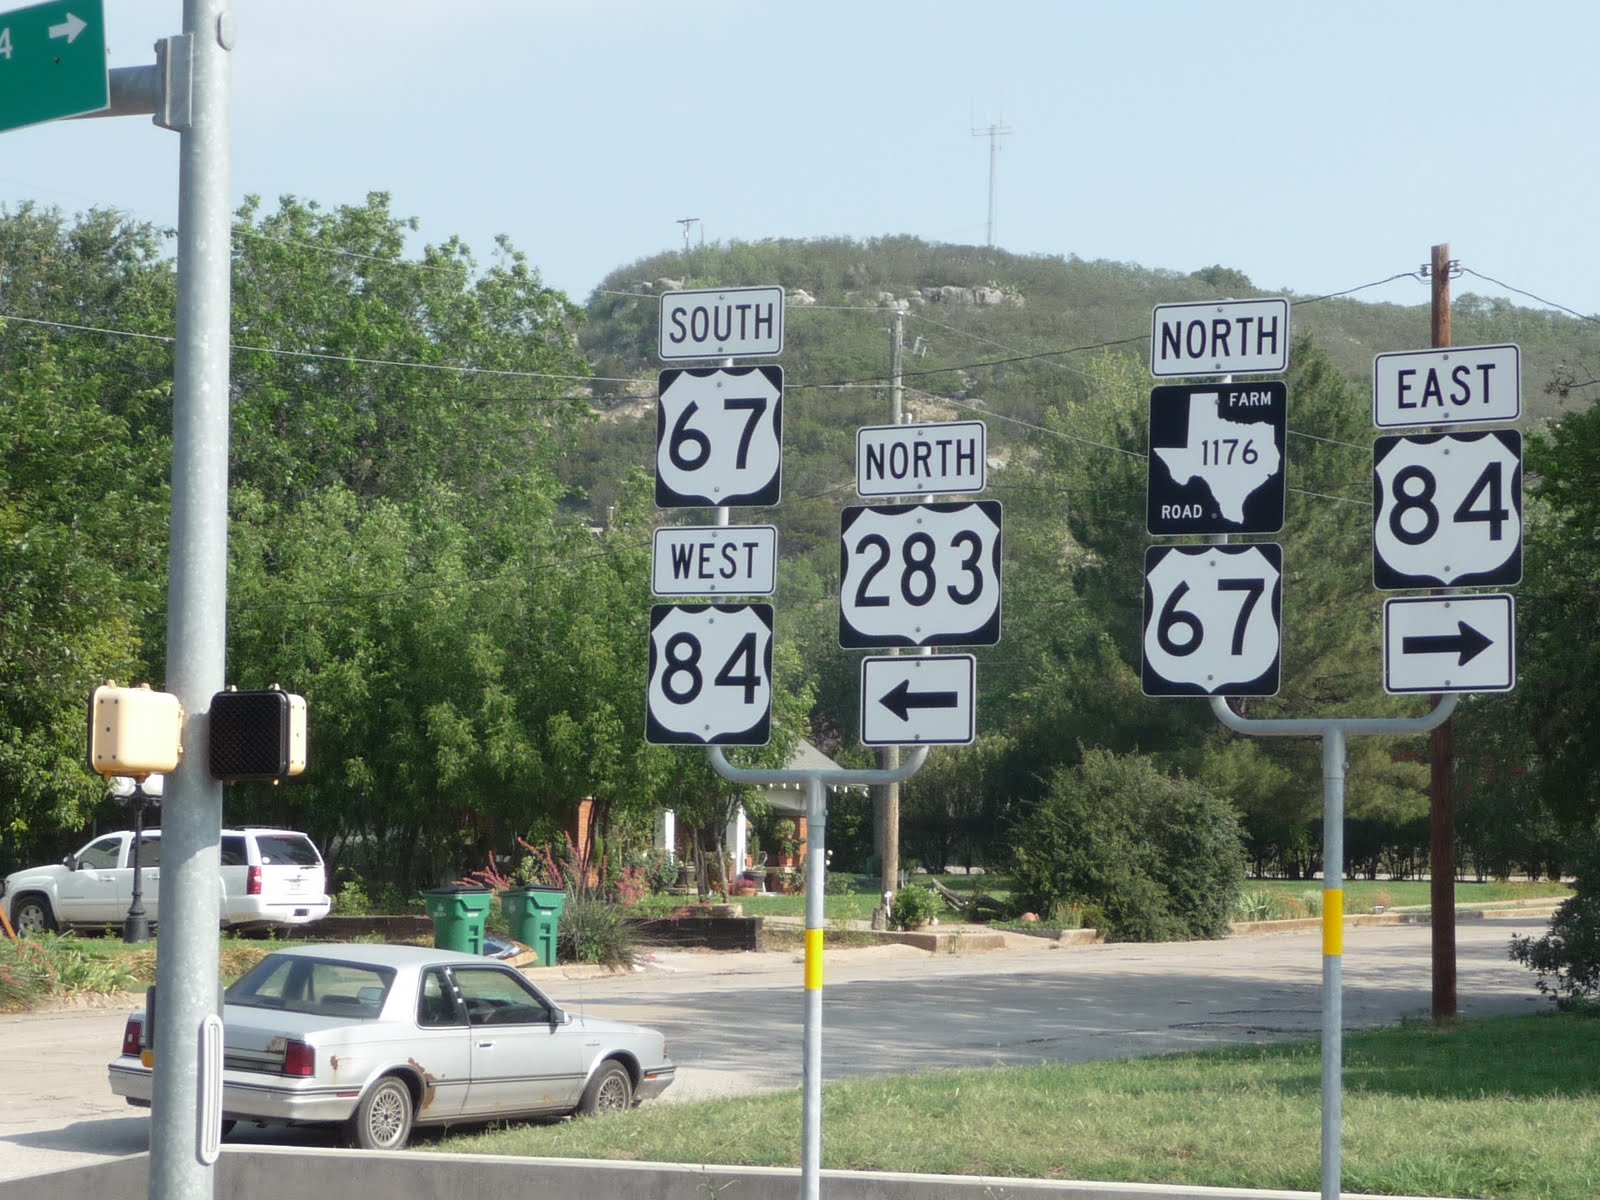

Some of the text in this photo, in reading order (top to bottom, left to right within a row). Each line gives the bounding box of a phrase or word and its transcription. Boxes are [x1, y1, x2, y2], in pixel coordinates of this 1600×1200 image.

[669, 302, 773, 343] SOUTH
[1161, 315, 1278, 360] NORTH
[1229, 391, 1272, 407] FARM
[1397, 363, 1496, 410] EAST
[668, 397, 768, 472] 67
[1201, 438, 1259, 466] 1176
[866, 438, 975, 481] NORTH
[1161, 504, 1203, 519] ROAD
[1388, 461, 1510, 546] 84
[670, 542, 759, 580] WEST
[854, 529, 984, 608] 283
[1156, 577, 1265, 658] 67
[660, 631, 762, 706] 84
